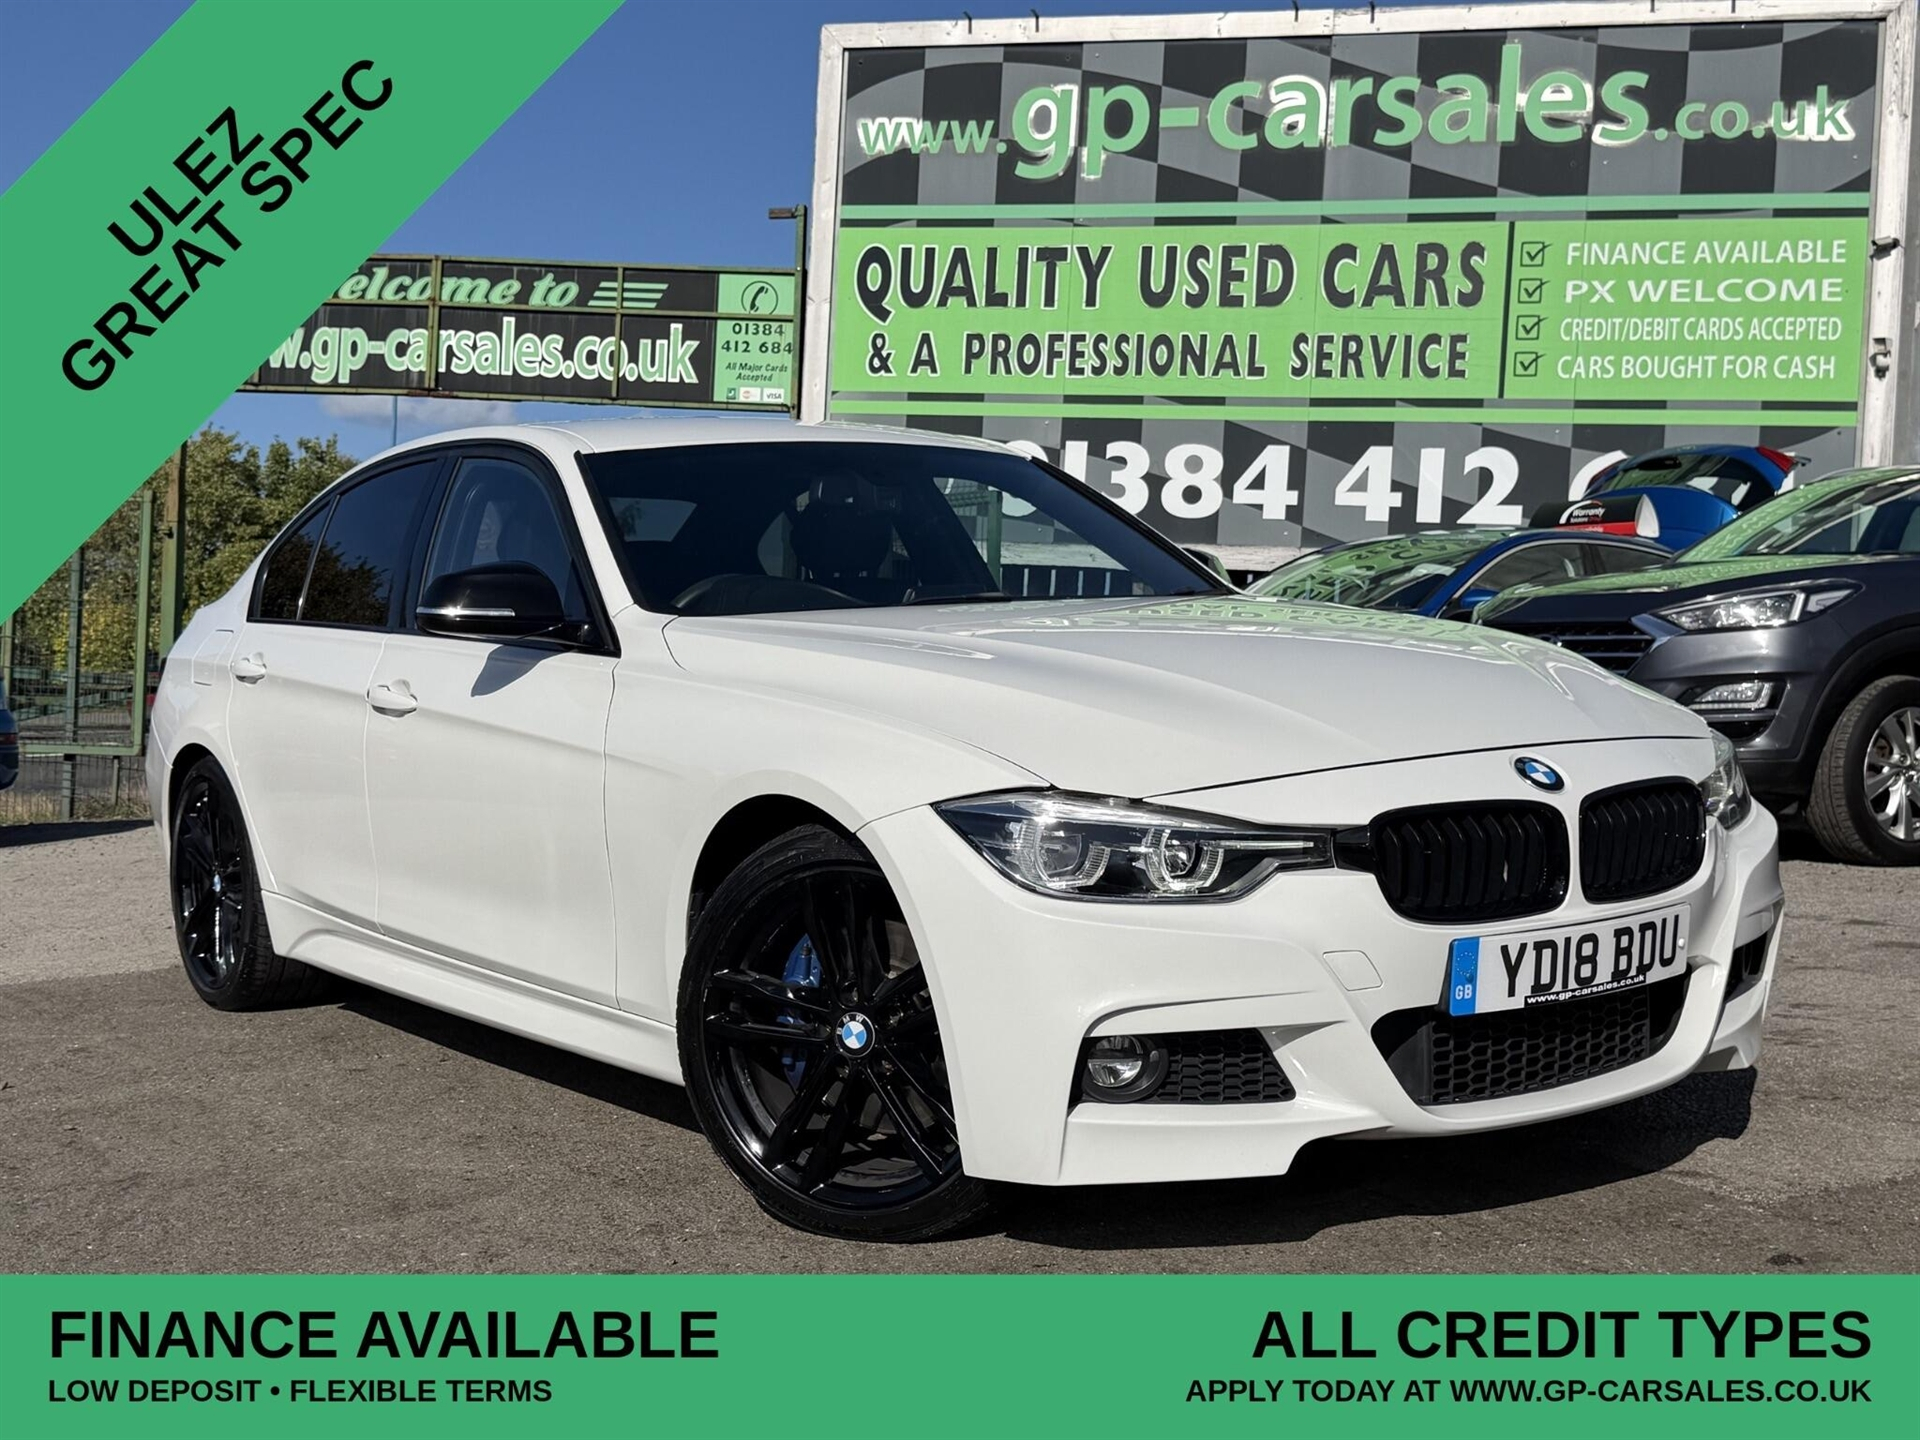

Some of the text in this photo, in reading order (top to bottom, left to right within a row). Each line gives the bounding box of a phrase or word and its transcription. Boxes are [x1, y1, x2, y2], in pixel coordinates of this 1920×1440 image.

[857, 42, 1856, 180] www.gp-carsales.co.uk
[1567, 239, 1847, 265] FINANCE AVAILABLE
[337, 265, 579, 308] elcome to
[855, 240, 1487, 324] QUALITY USED CARS
[1565, 278, 1843, 303] PX WELCOME
[732, 322, 785, 337] 01384
[1560, 316, 1841, 342] CREDIT/DEBIT CARDS ACCEPTED
[721, 340, 793, 355] 412 684
[867, 331, 1470, 380] & A PROFESSIONAL SERVICE
[725, 362, 788, 373] All Major Cards
[735, 373, 774, 383] Accepted
[1557, 355, 1835, 379] CARS BOUGHT FOR CASH
[1334, 446, 1523, 526] 412
[1572, 507, 1606, 518] Warranty
[1500, 914, 1680, 998] YD18 BDU
[1455, 985, 1472, 999] GB
[1526, 974, 1645, 1004] www.gp-carsales.co.uk
